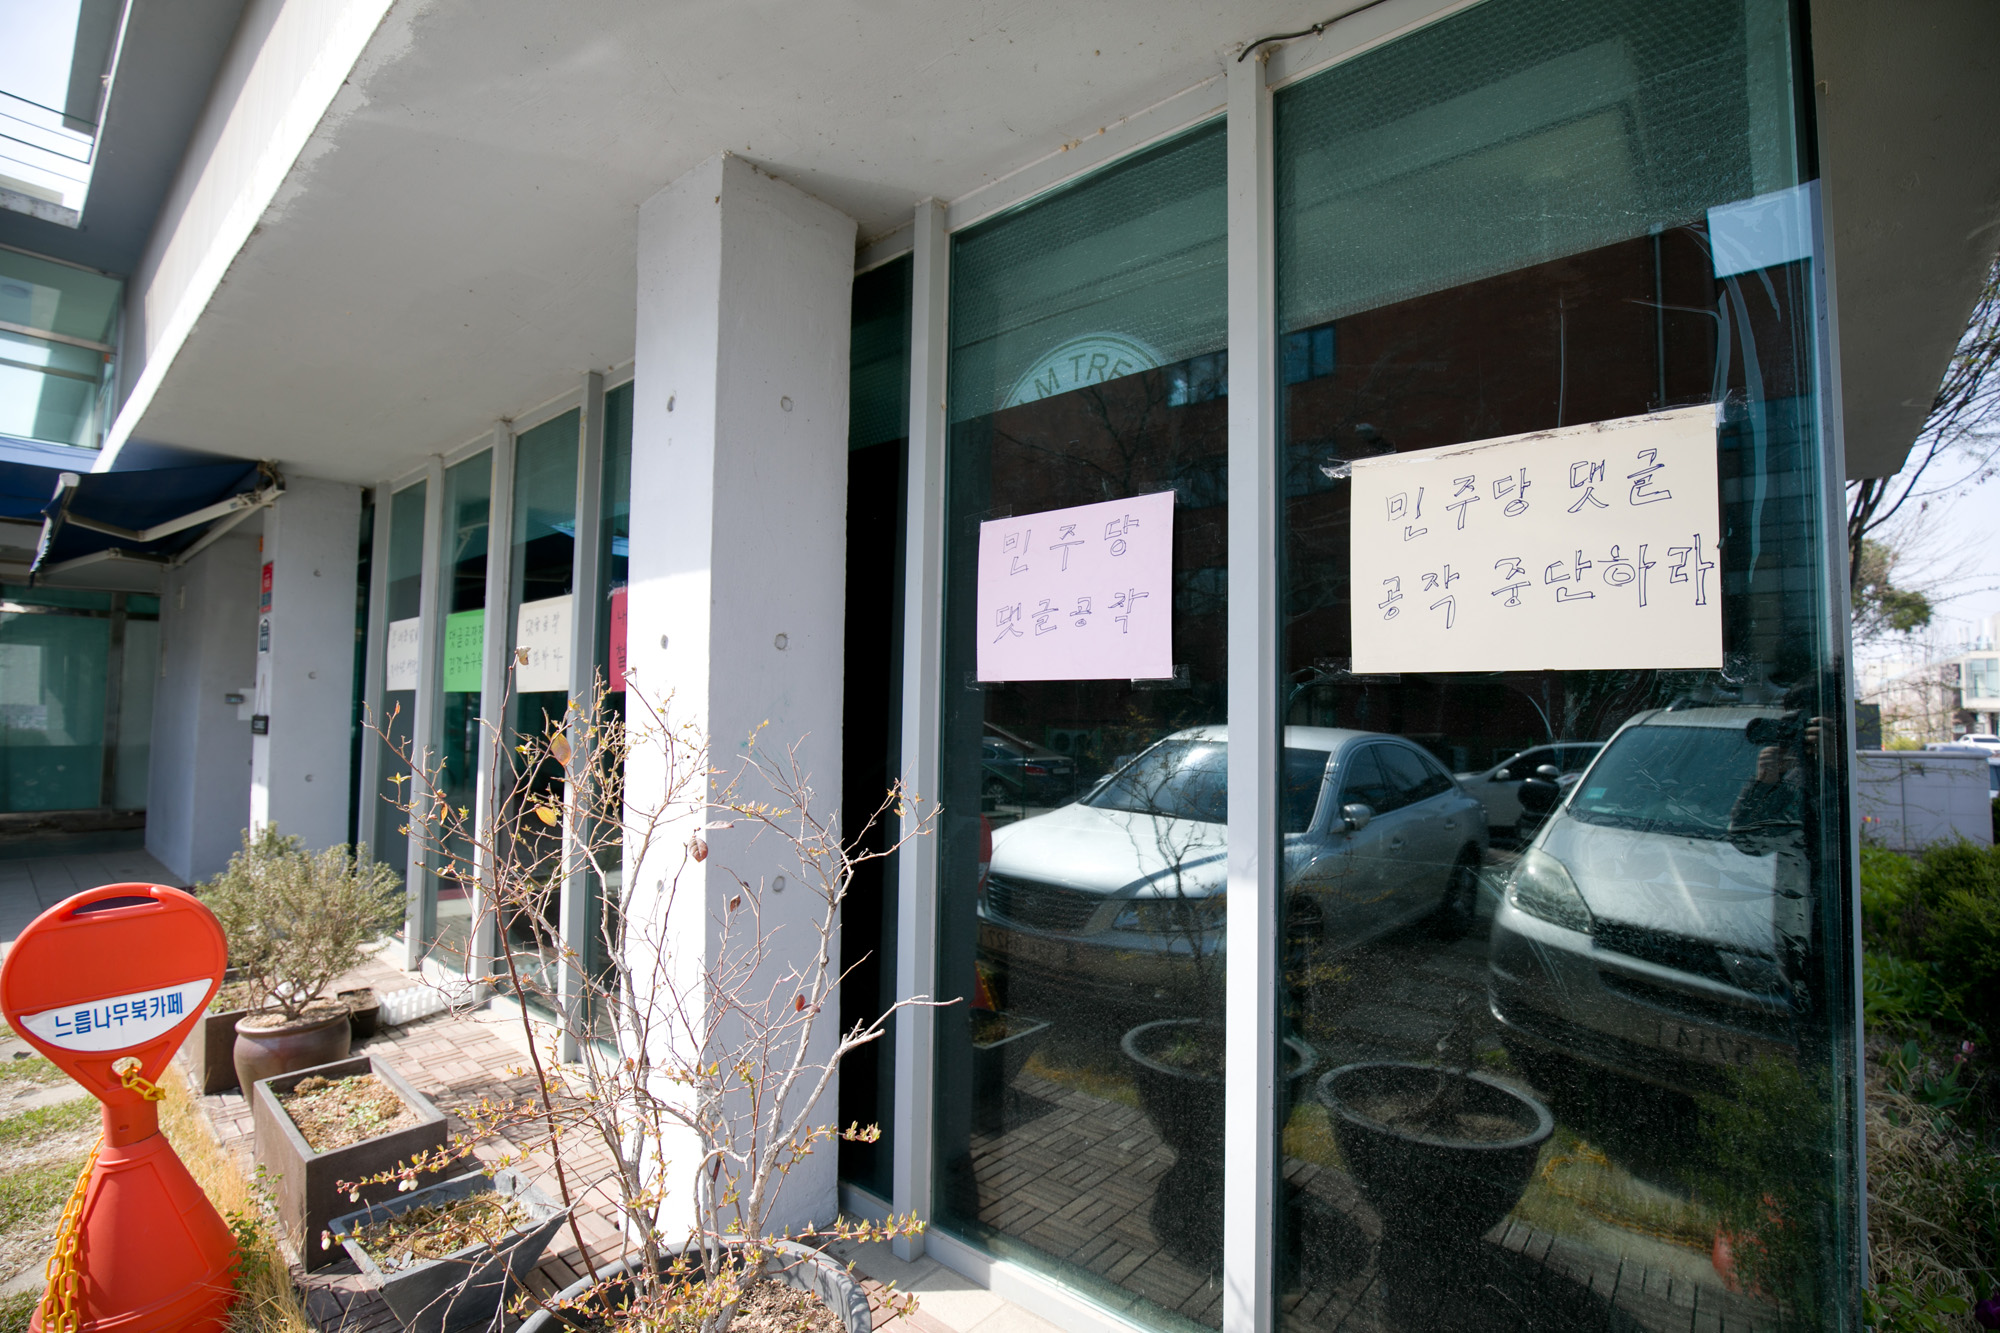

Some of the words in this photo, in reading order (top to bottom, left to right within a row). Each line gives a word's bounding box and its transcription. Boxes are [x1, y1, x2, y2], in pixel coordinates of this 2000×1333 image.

[1386, 467, 1531, 542] 민주당
[1567, 448, 1672, 514] 댓글
[1003, 516, 1139, 575] 민주당
[1378, 564, 1460, 630] 공작
[1491, 533, 1715, 608] 중단하라
[55, 992, 183, 1038] 느릅나무북카페
